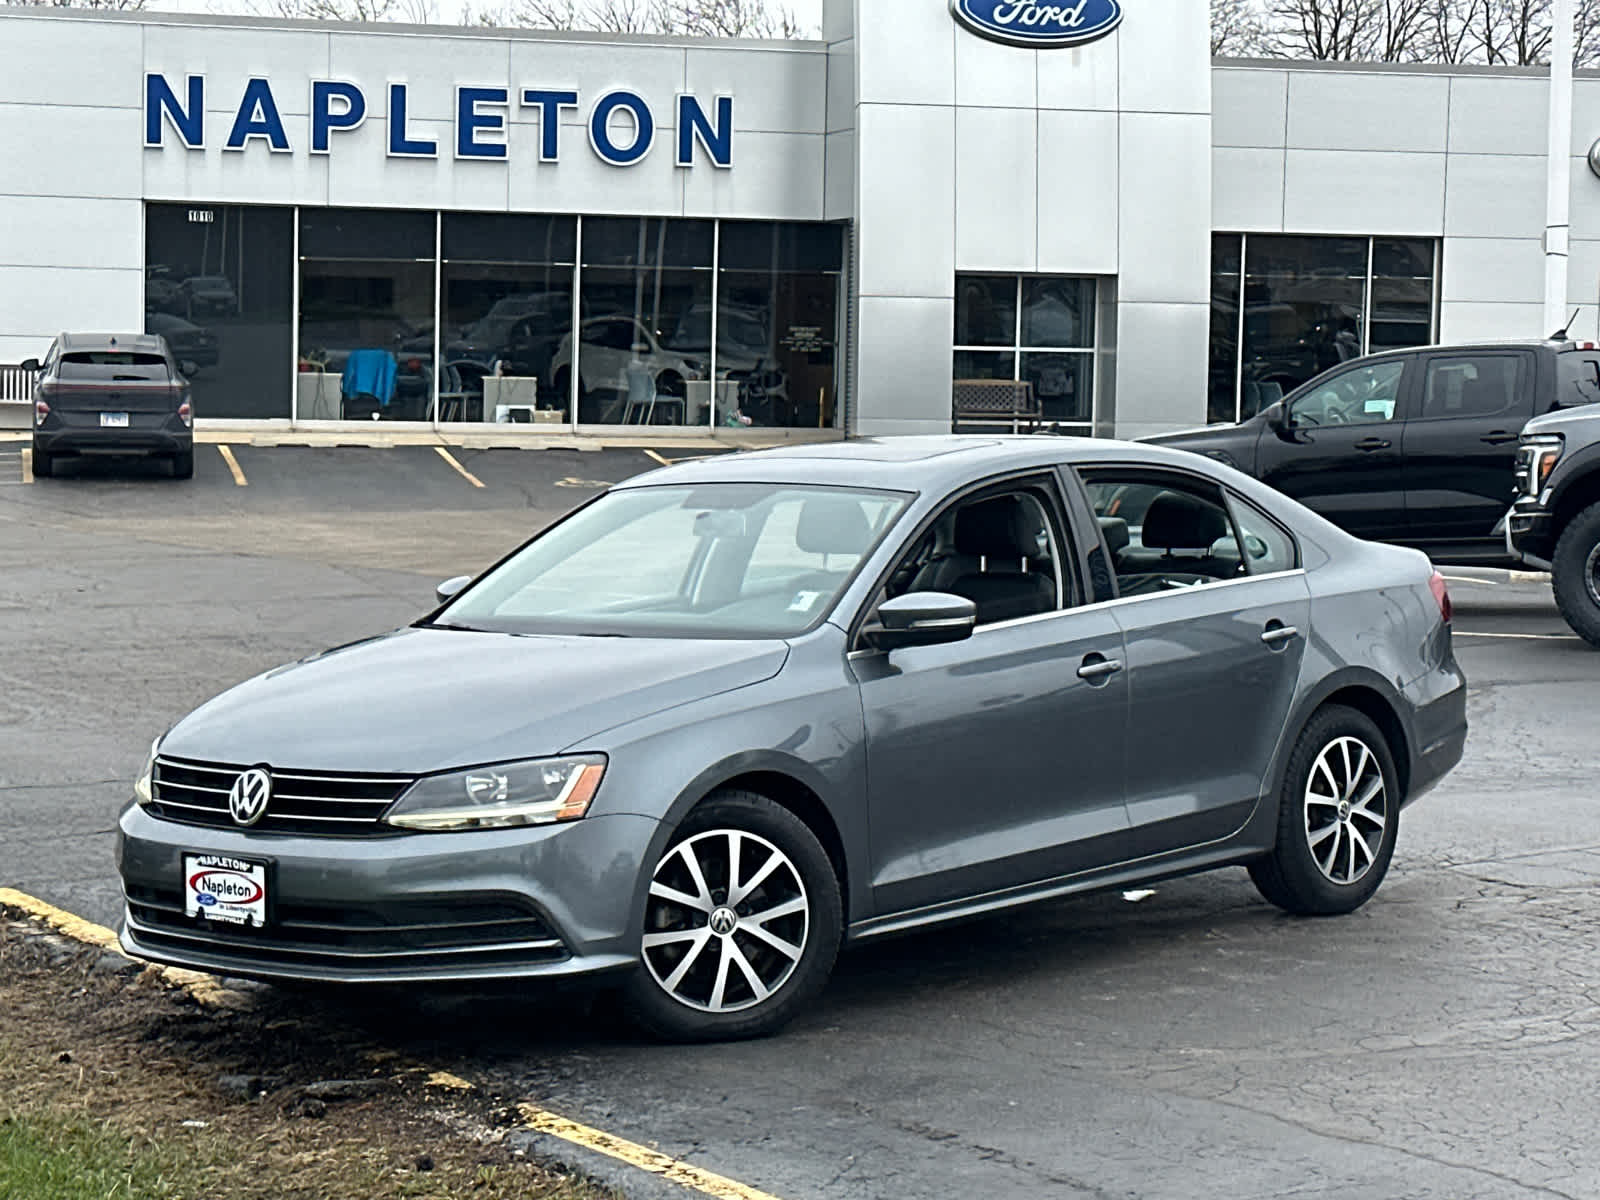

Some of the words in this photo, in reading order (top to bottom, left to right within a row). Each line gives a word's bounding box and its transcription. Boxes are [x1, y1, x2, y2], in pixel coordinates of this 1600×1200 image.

[993, 0, 1086, 27] Ford
[144, 73, 733, 168] NAPLETON
[188, 209, 214, 223] 1010
[202, 876, 251, 897] Napleton
